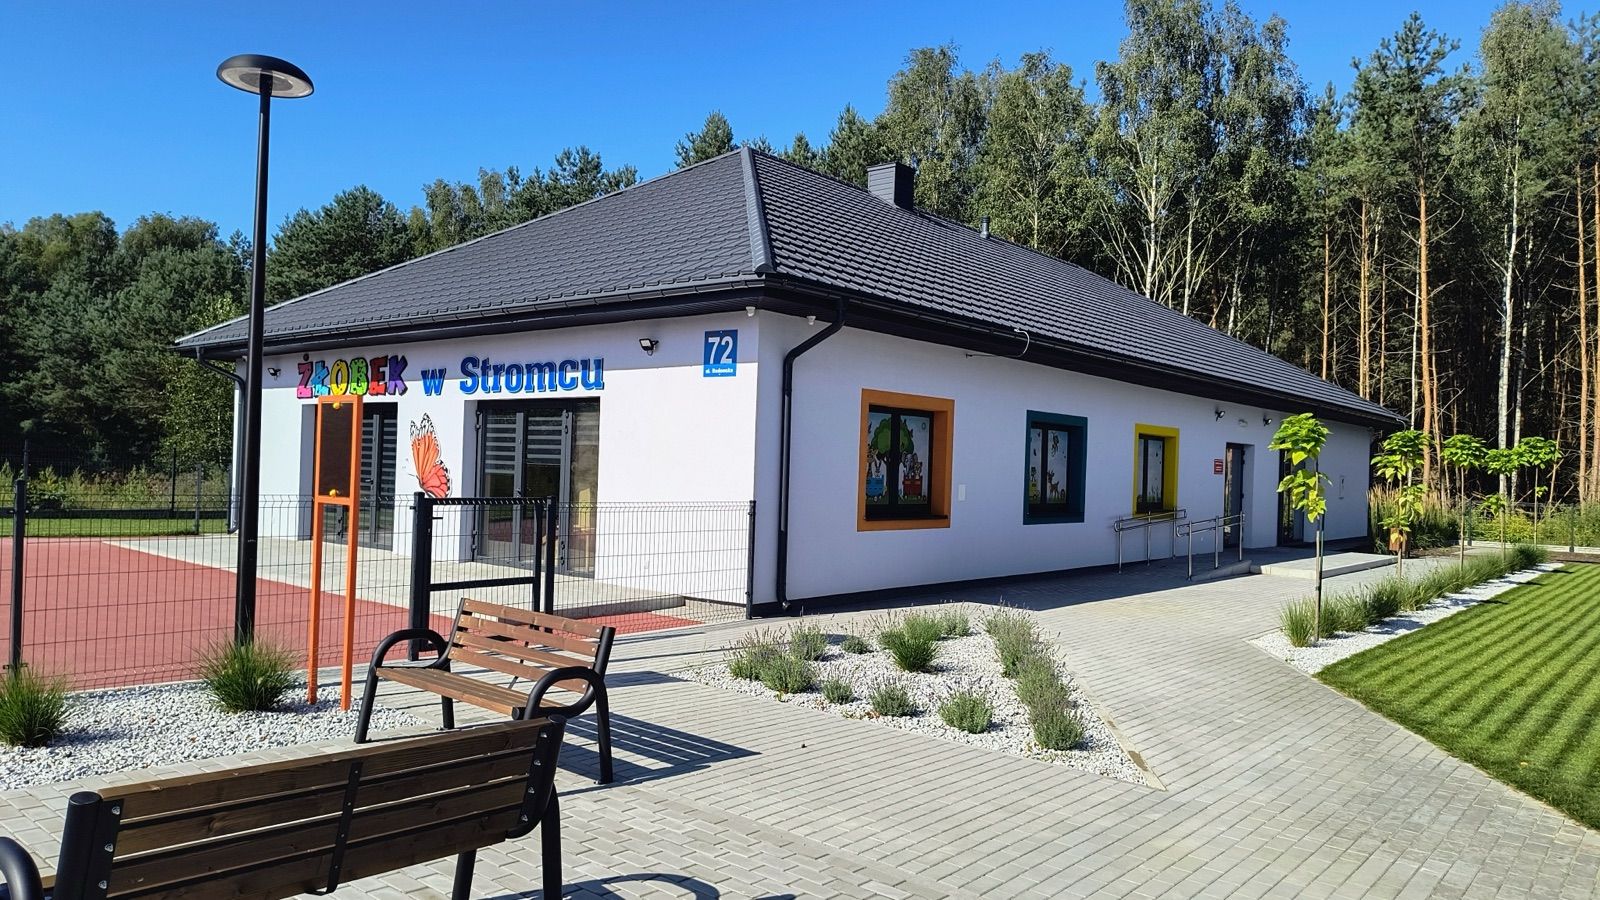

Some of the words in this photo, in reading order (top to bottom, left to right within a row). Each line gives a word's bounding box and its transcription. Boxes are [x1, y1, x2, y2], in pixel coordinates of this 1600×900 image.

[708, 336, 733, 364] 72
[297, 353, 408, 398] ŻŁOBEK
[421, 367, 446, 396] w
[459, 356, 605, 394] Stromcu
